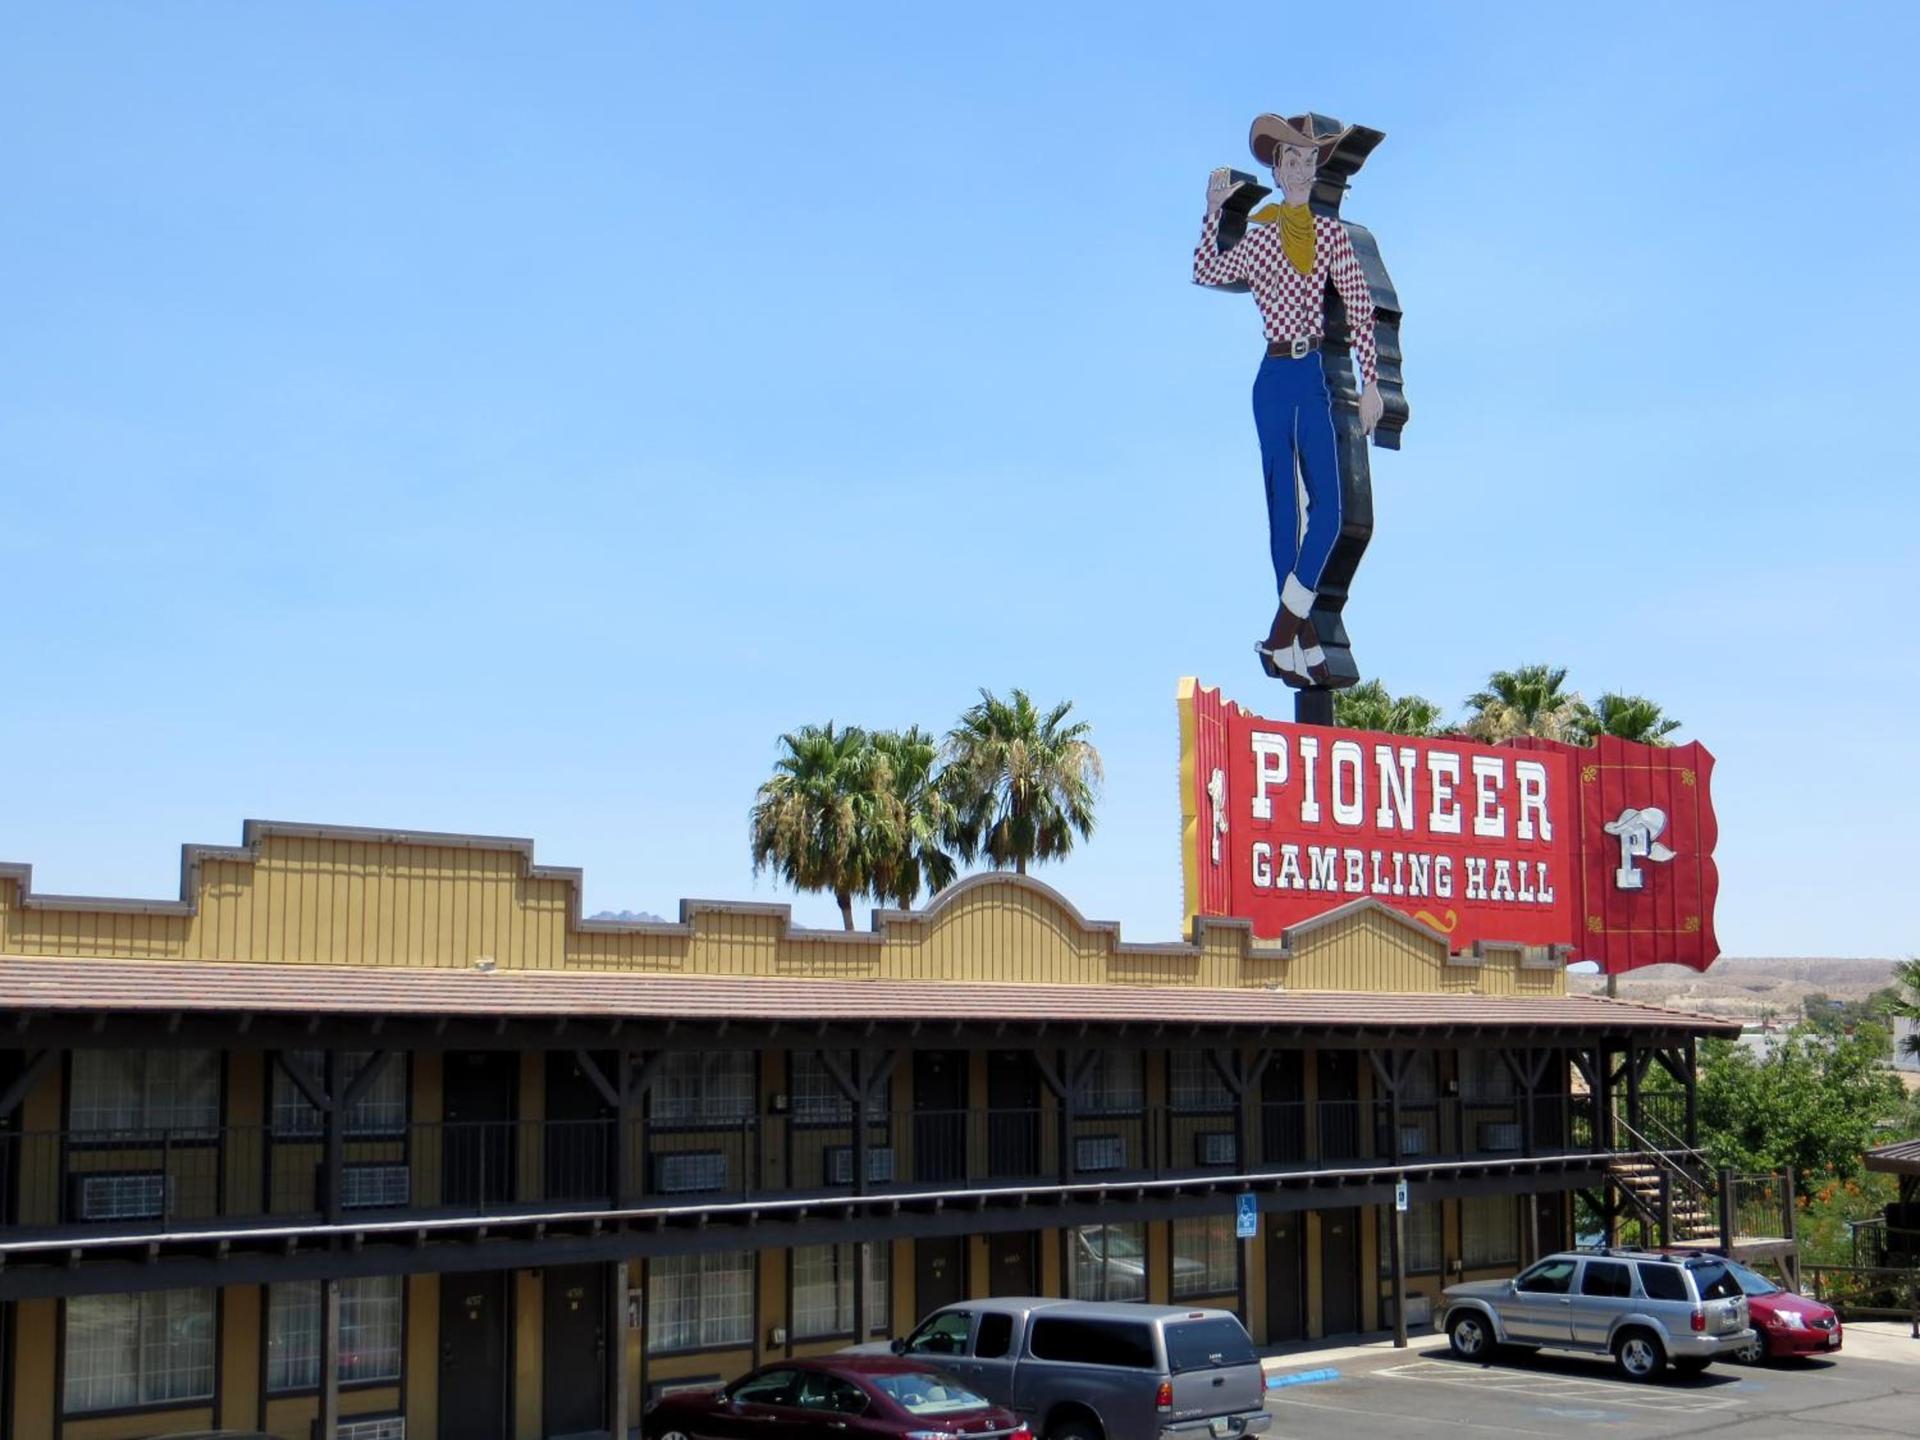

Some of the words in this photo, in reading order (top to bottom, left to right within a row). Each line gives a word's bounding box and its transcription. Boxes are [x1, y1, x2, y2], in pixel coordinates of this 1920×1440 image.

[1251, 731, 1553, 842] PIONEER
[1252, 841, 1452, 898] GAMBLING
[1465, 856, 1554, 904] HALL
